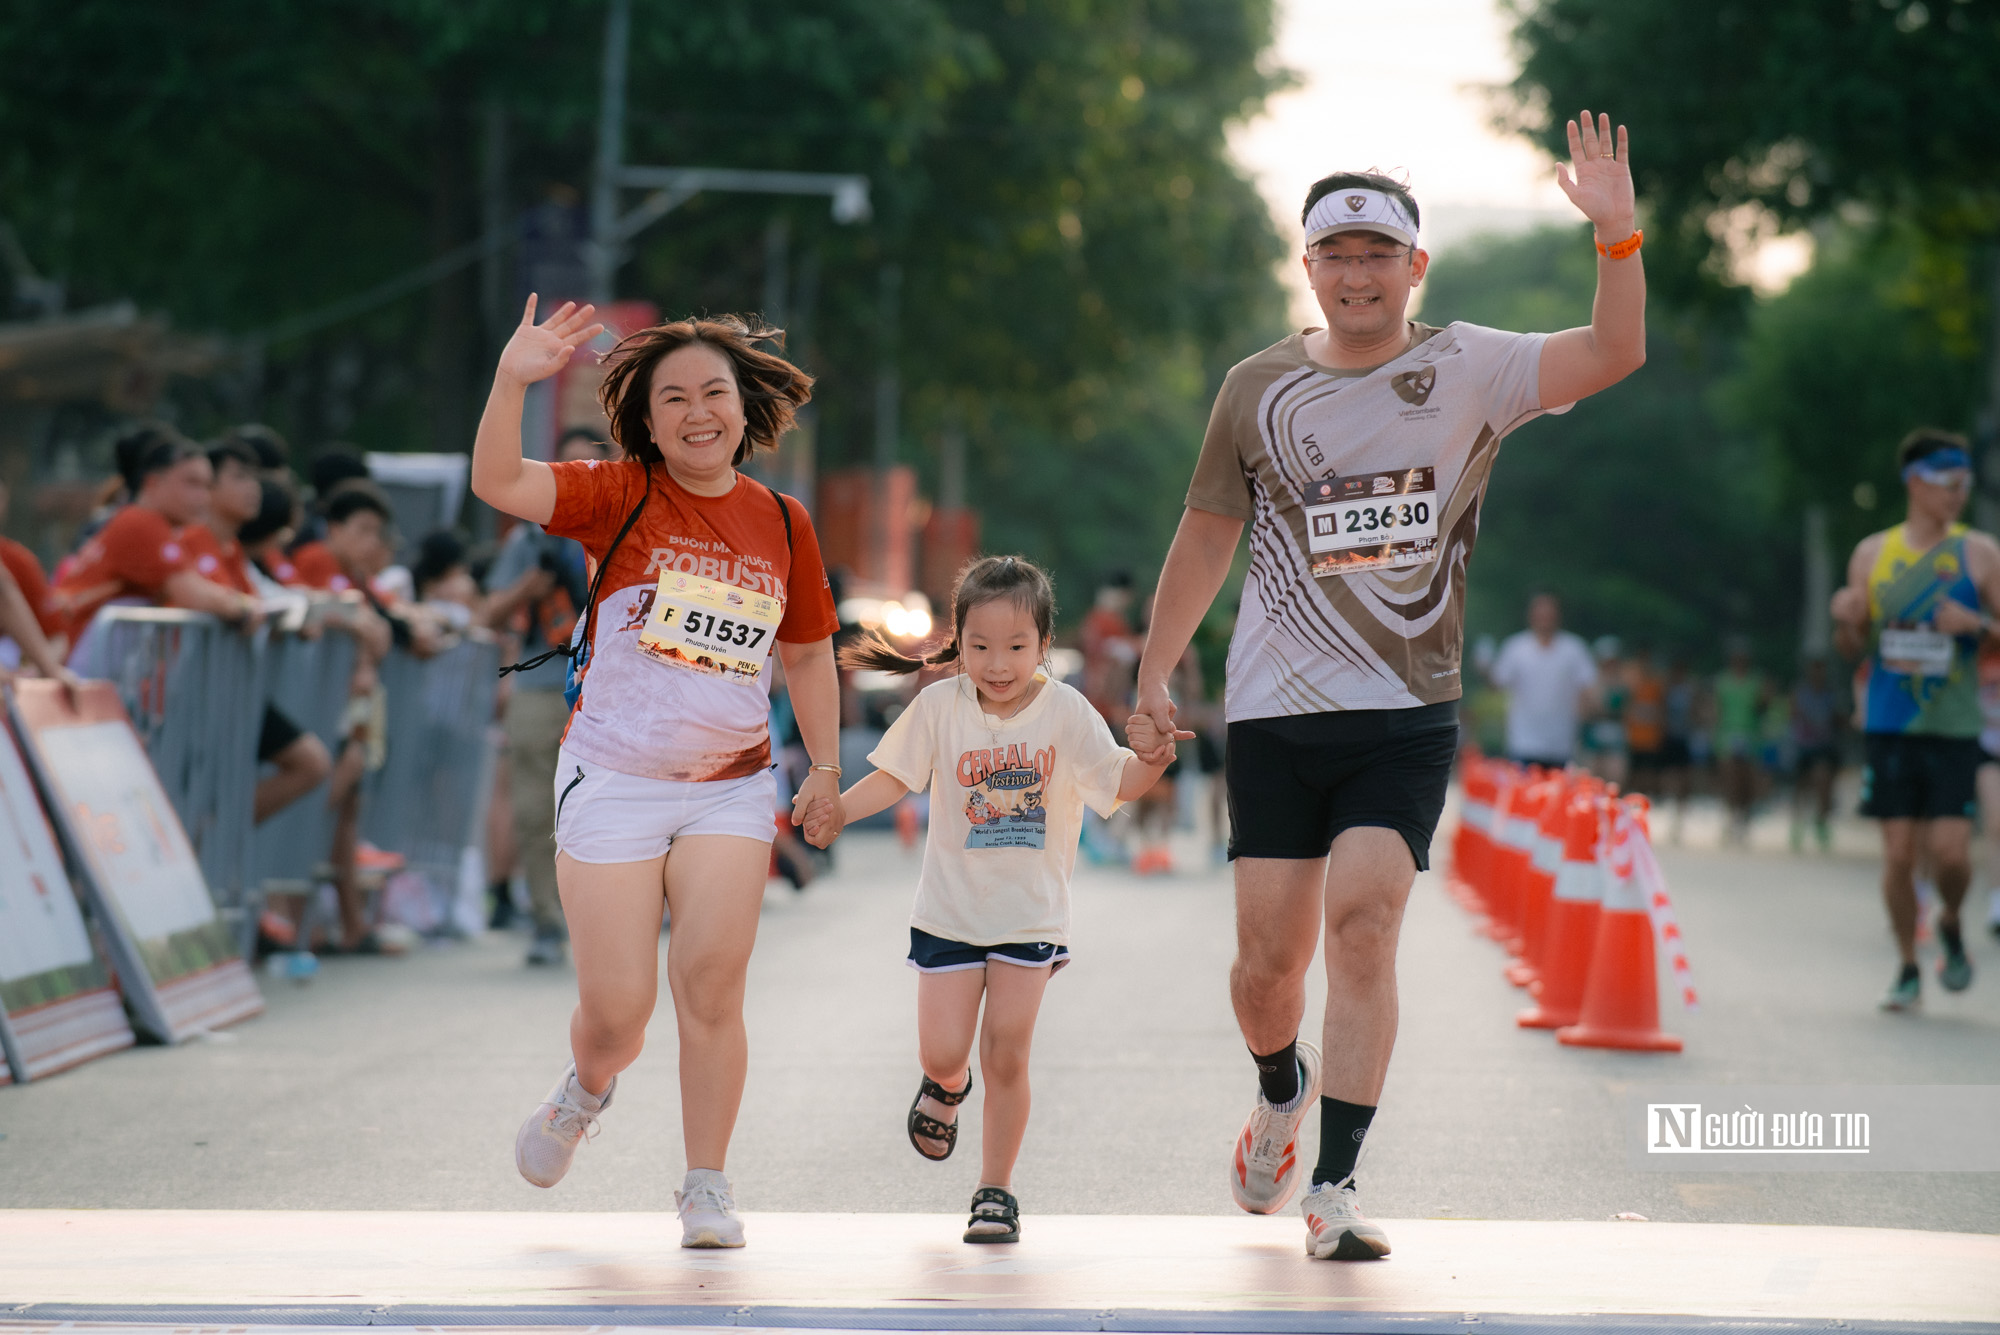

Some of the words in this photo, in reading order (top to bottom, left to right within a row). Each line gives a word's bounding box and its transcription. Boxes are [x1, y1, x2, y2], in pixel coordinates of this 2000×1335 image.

[1398, 406, 1441, 417] Vietcombank
[1302, 433, 1325, 467] VCB
[1321, 468, 1340, 480] R
[1318, 516, 1332, 534] M
[1345, 502, 1429, 533] 23630
[669, 535, 709, 551] BUÔN
[735, 554, 772, 571] HUỘT
[1414, 539, 1426, 548] PEN
[643, 548, 786, 603] ROBUSTA
[664, 608, 675, 622] F
[684, 611, 766, 648] 51537
[738, 661, 750, 670] PEN
[957, 742, 1033, 787] CEREAL
[987, 768, 1037, 792] festival
